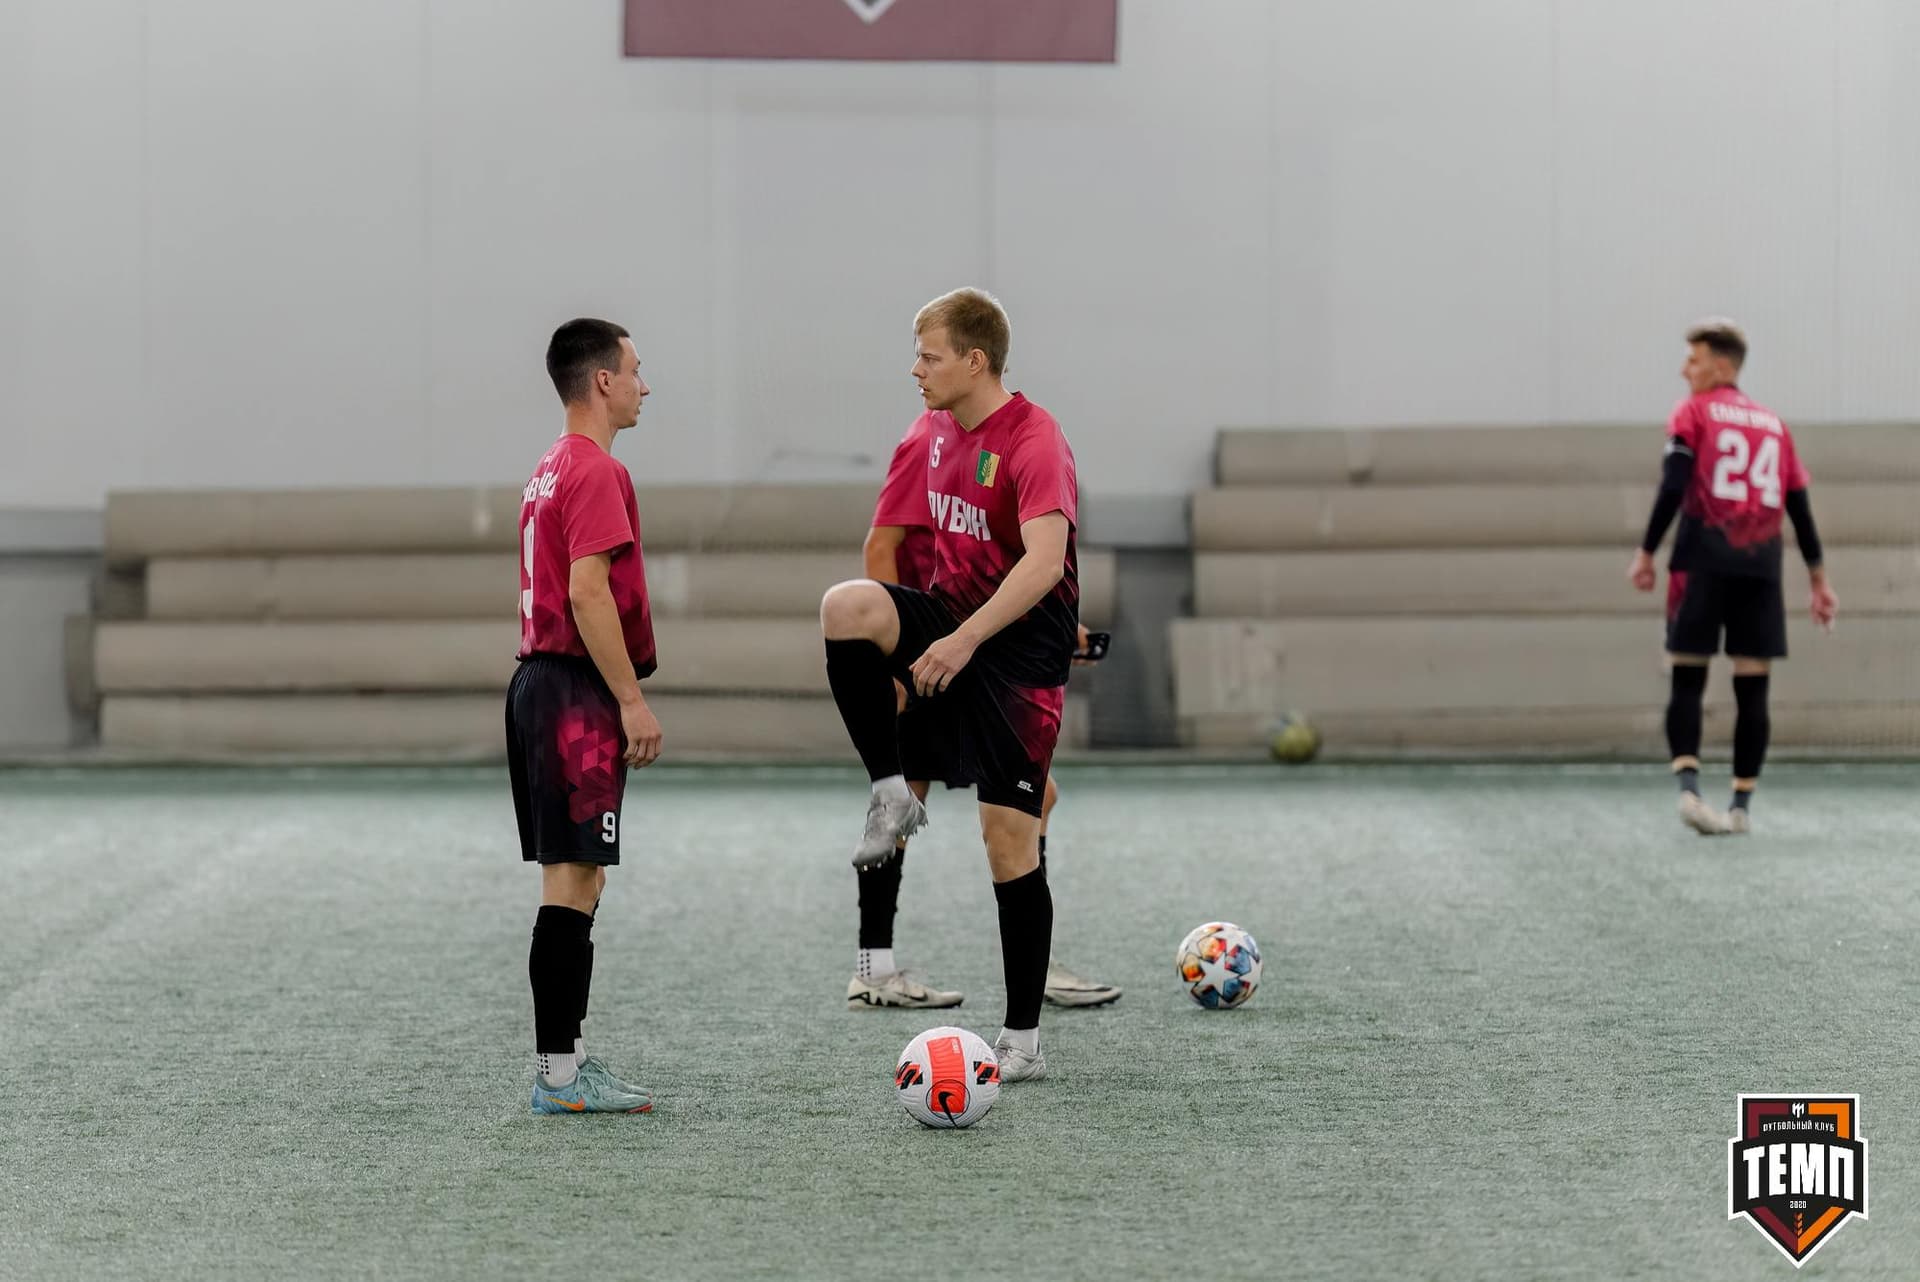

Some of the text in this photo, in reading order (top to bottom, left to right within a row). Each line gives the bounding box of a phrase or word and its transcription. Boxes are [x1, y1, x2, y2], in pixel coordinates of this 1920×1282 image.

[931, 436, 944, 468] 5
[1712, 428, 1780, 509] 24
[602, 811, 616, 843] 9
